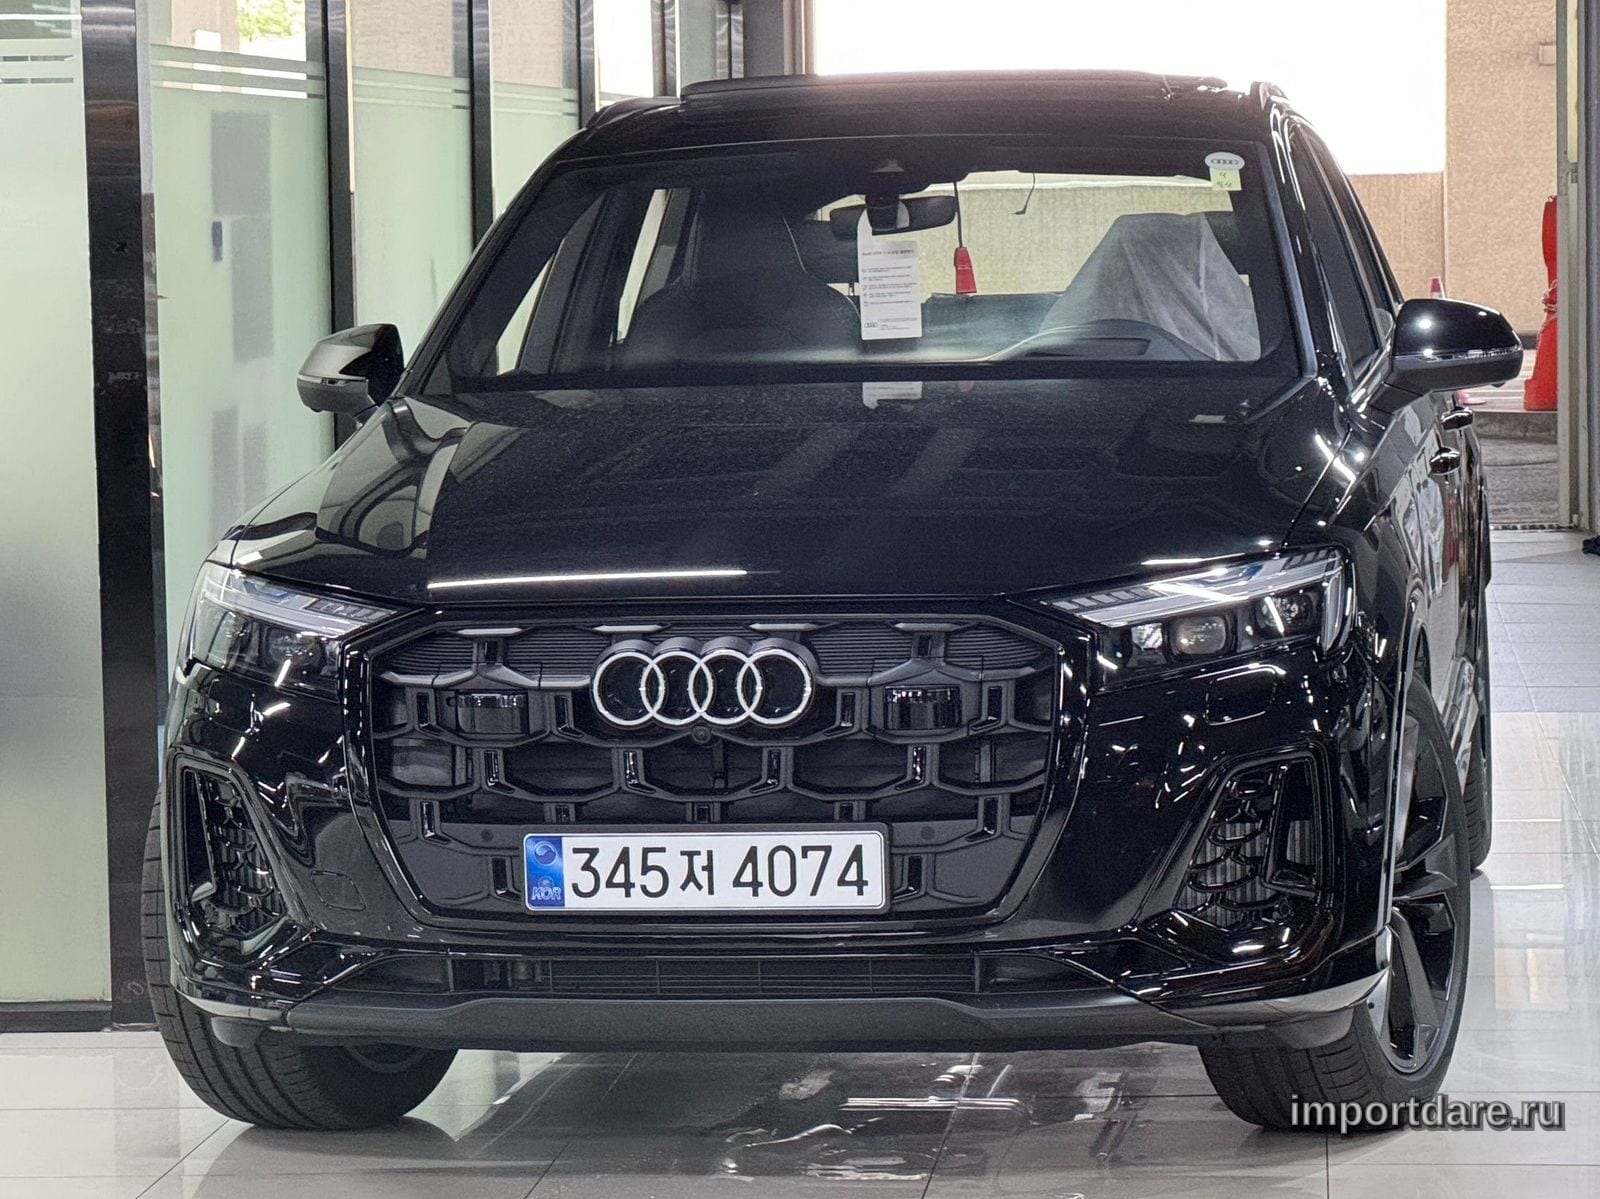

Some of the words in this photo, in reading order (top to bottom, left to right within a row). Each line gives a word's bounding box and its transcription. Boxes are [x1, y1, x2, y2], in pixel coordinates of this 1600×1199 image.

[571, 847, 715, 898] 345저
[732, 844, 869, 897] 4074
[531, 886, 562, 900] KOR
